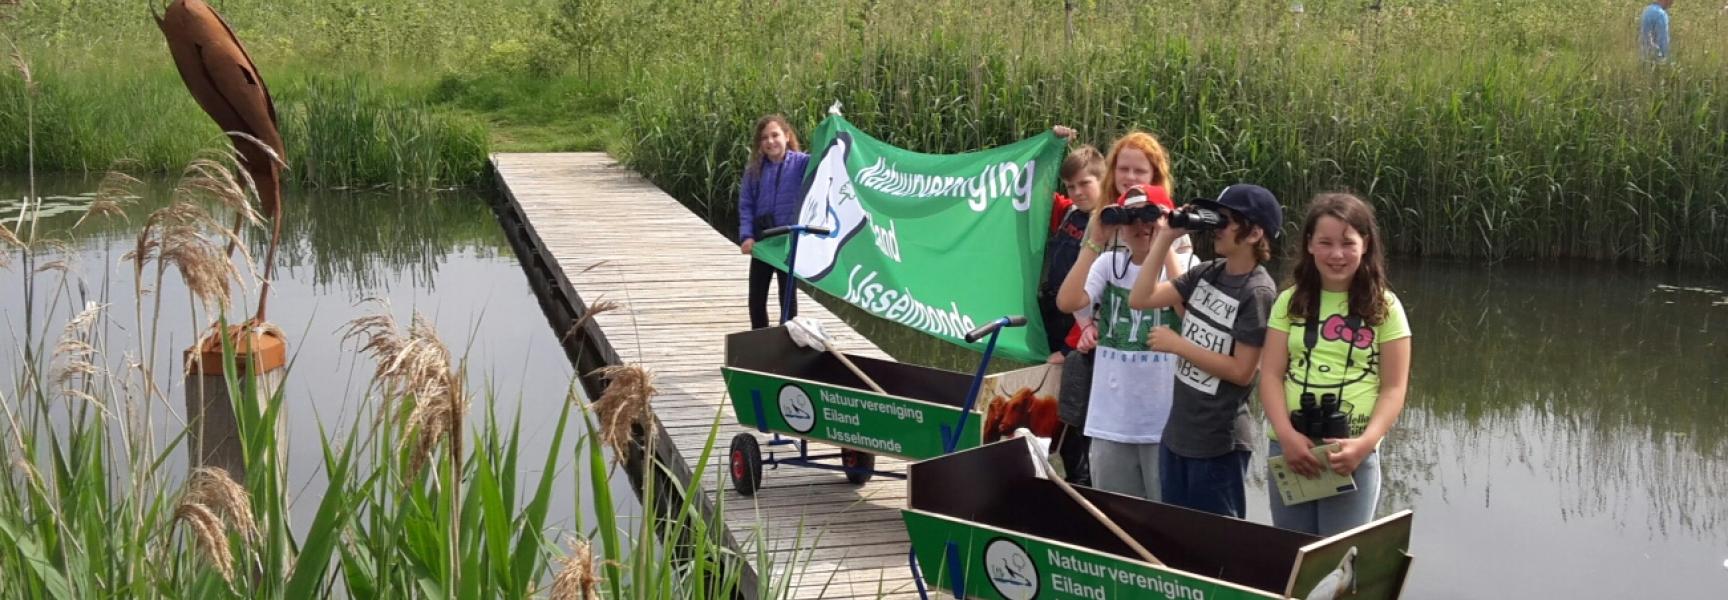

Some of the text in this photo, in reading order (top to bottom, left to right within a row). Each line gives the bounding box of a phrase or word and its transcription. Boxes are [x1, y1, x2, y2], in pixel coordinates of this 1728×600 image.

[820, 389, 923, 423] Natuurvereniging
[823, 408, 860, 425] Eiland
[826, 427, 902, 452] IJsselmonde
[1048, 549, 1204, 600] Natuurvereniging
[1051, 574, 1105, 600] Eiland
